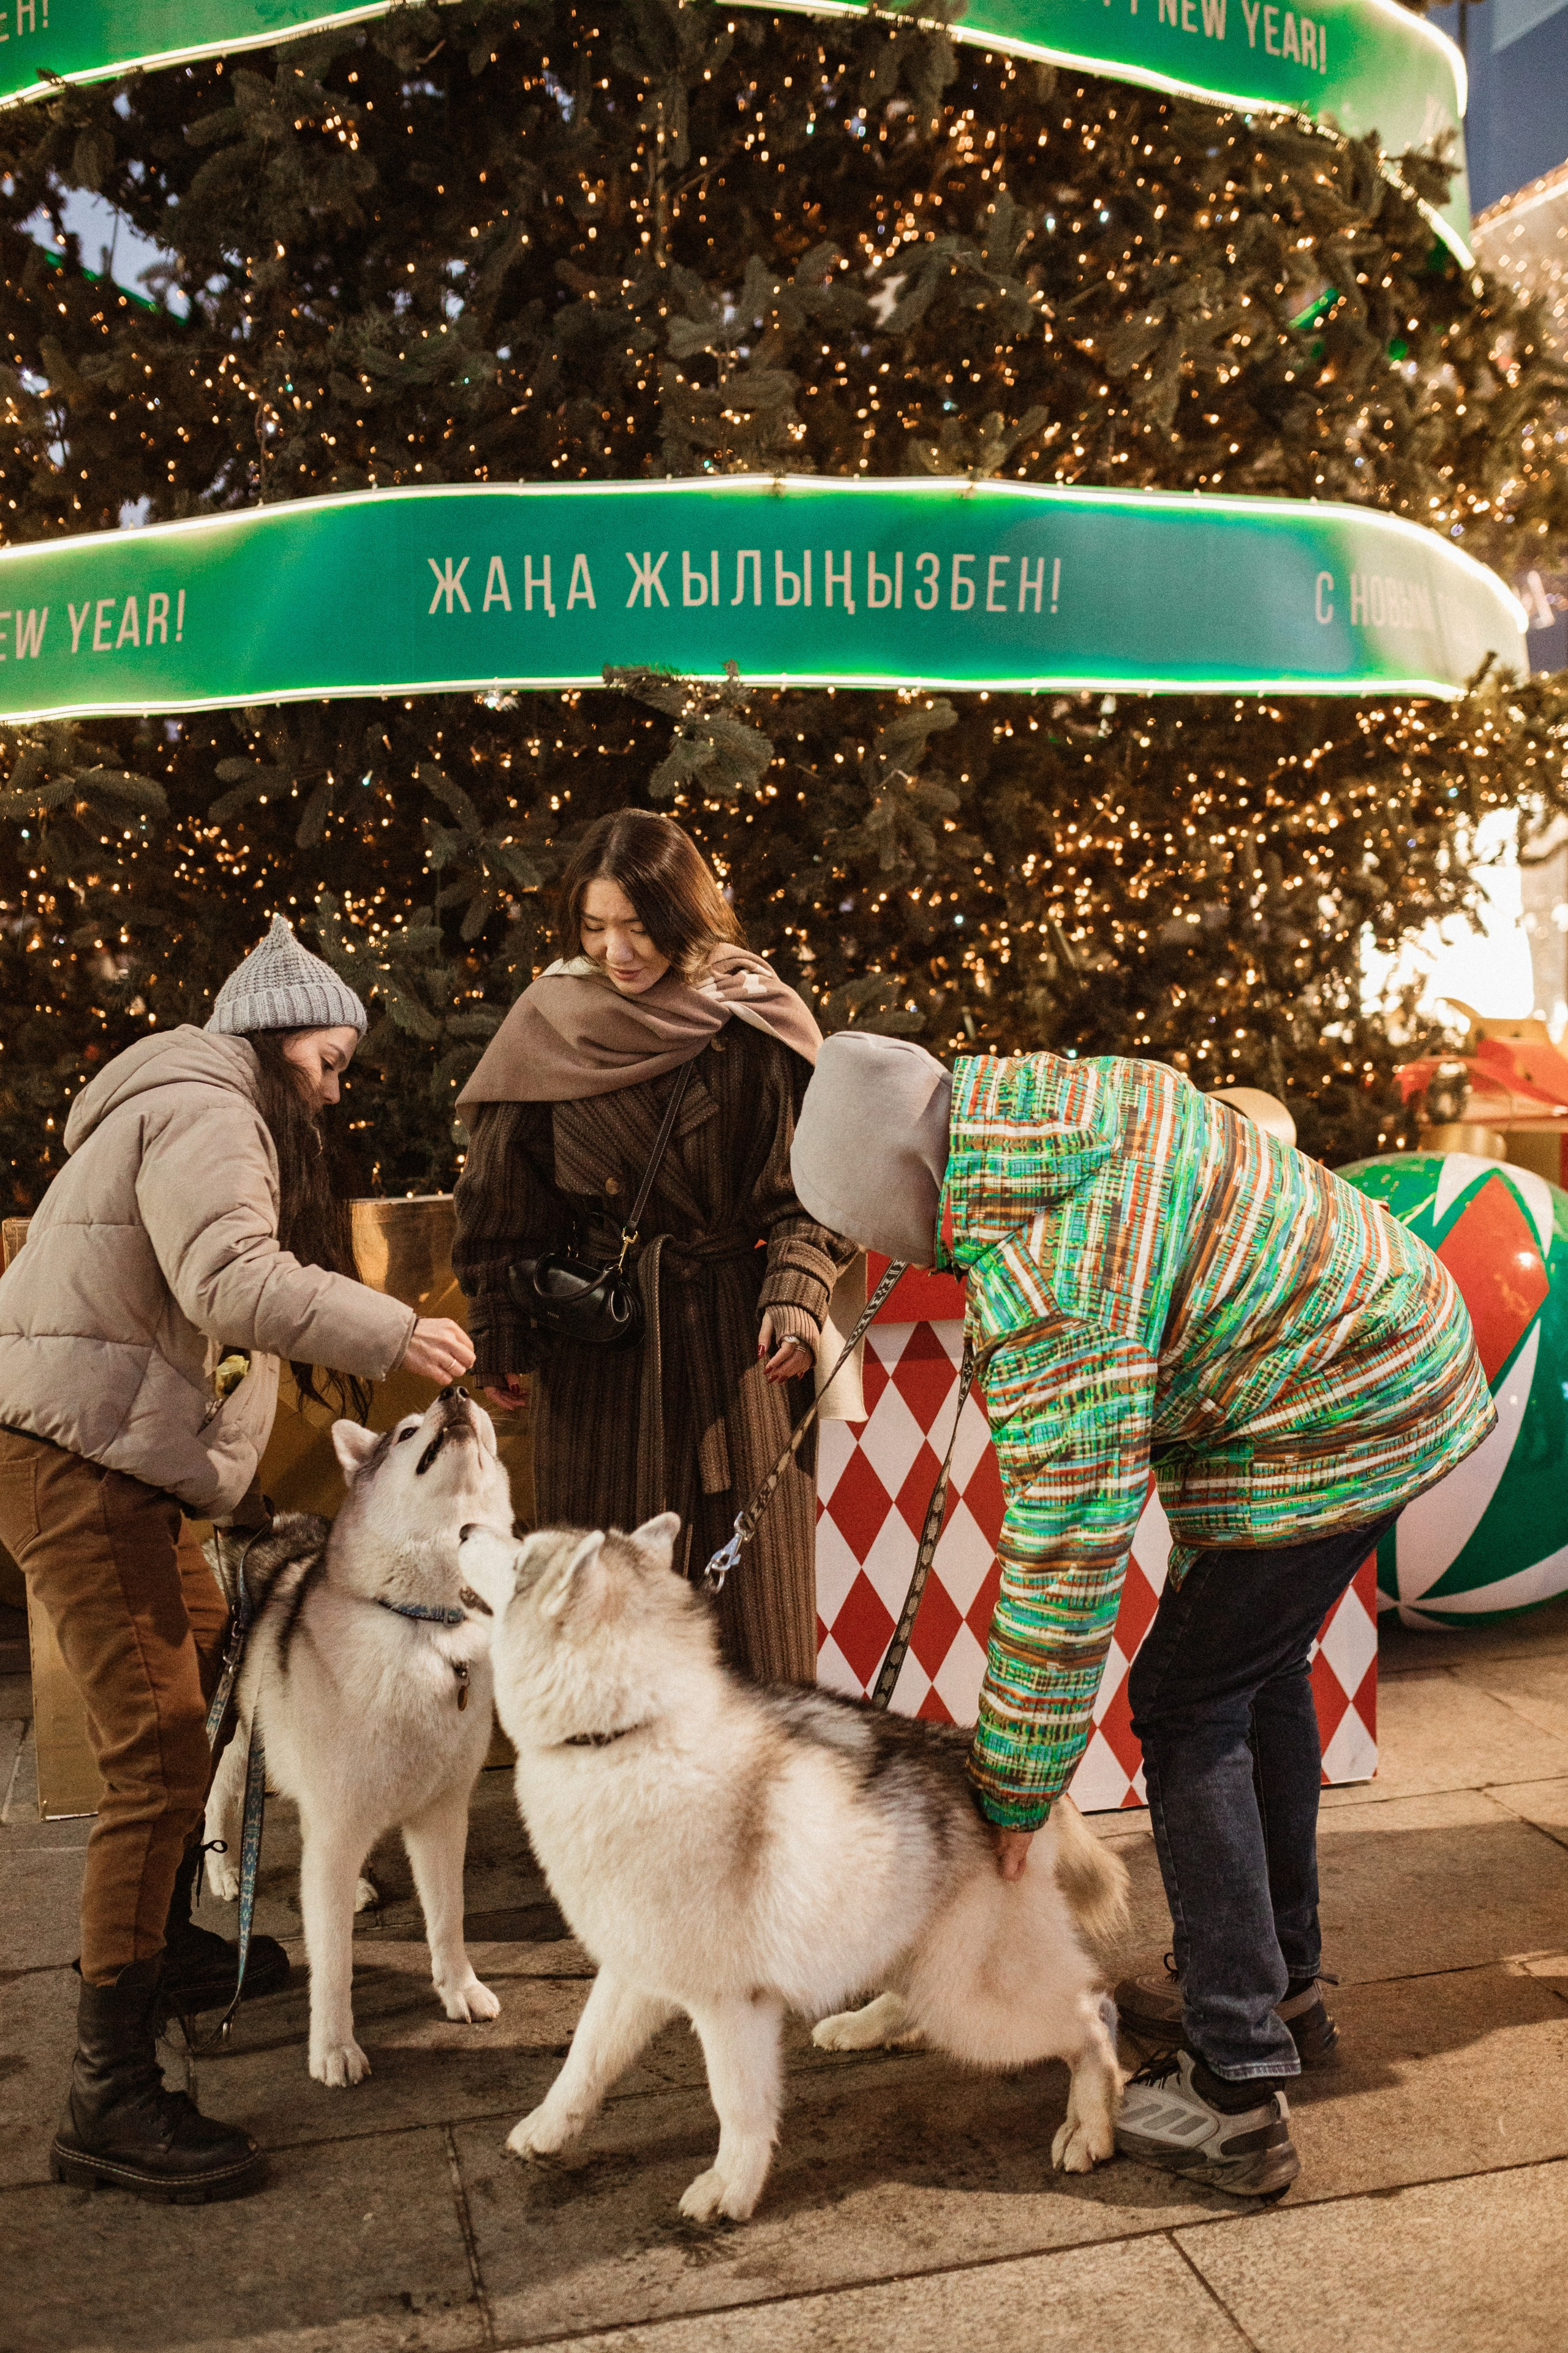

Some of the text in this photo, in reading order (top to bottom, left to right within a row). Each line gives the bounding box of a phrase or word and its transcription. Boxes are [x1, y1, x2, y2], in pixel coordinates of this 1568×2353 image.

[1242, 0, 1327, 74] YEAR!
[428, 550, 1061, 618] ЖАҢА ЖЫЛЫҢЫЗБЕН!
[1316, 571, 1334, 624] С
[67, 589, 186, 653] YEAR!
